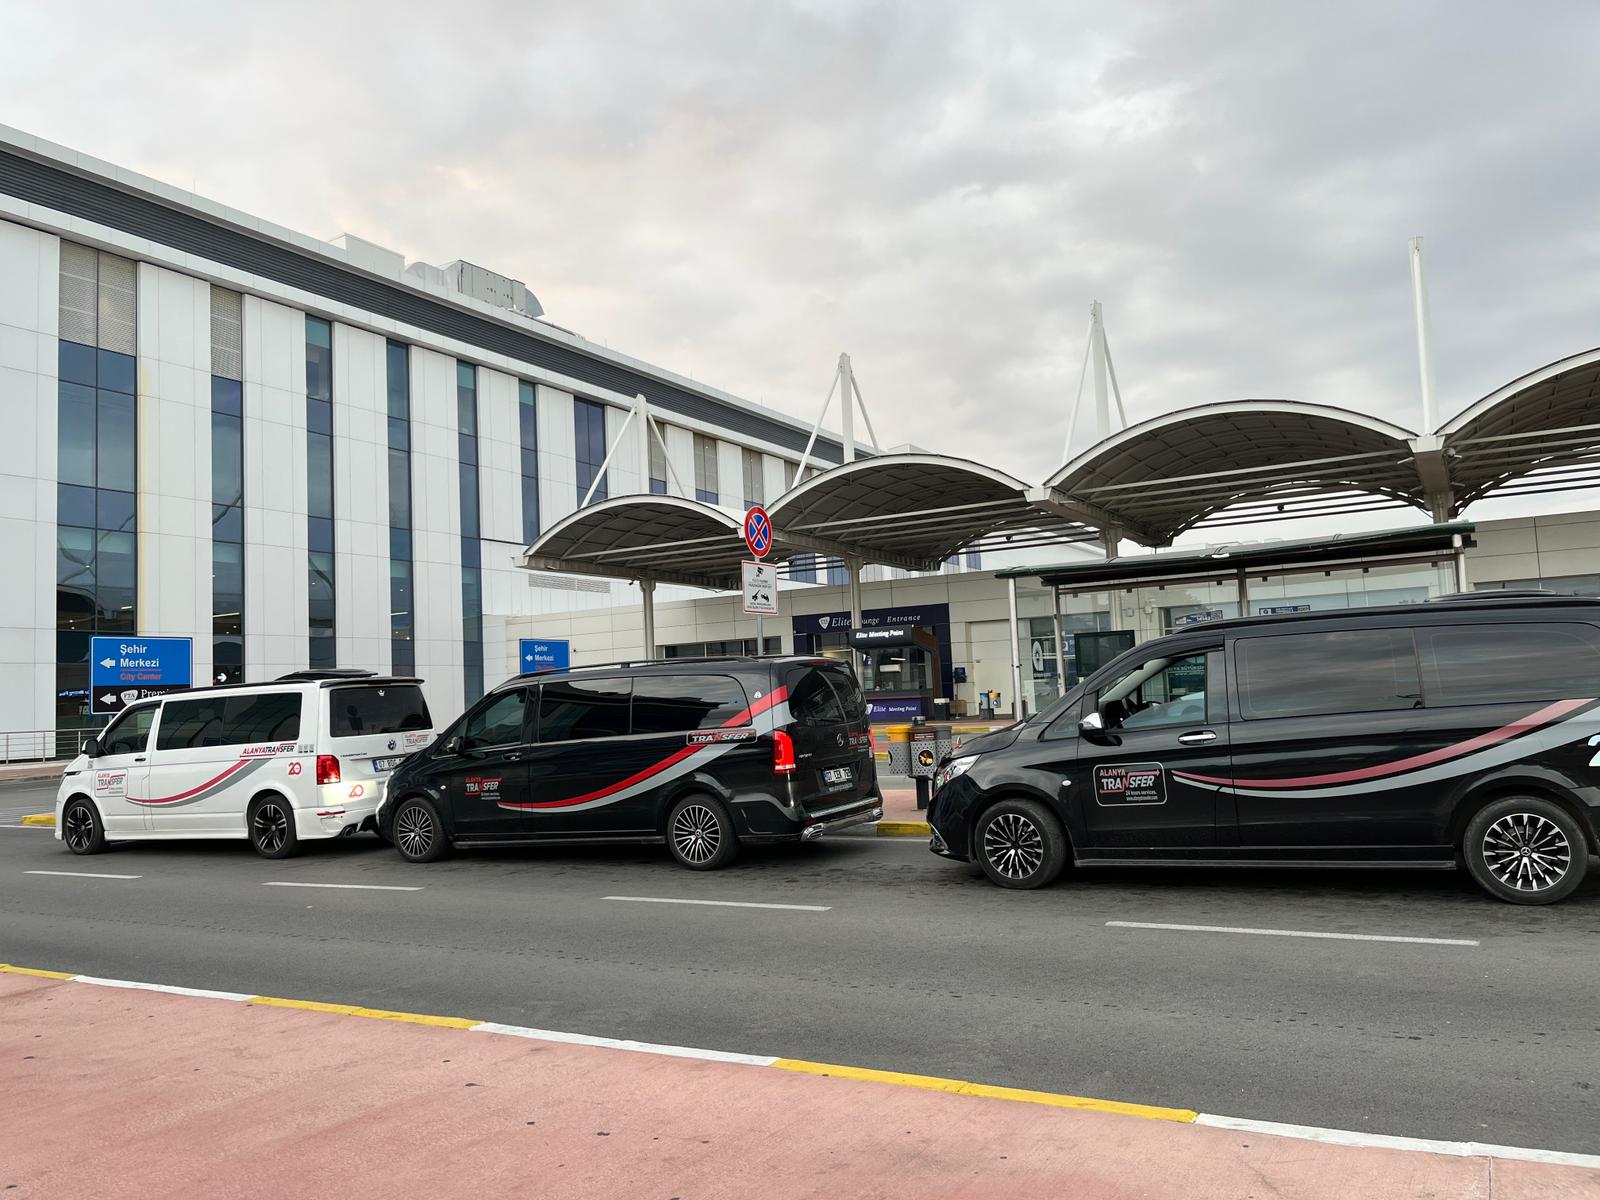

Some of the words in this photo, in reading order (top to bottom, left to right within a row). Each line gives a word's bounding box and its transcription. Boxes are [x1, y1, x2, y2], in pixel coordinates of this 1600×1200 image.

[831, 617, 852, 627] Elite
[886, 615, 920, 623] Entrance
[868, 630, 889, 638] Meeting
[889, 629, 904, 637] Point
[120, 644, 147, 655] Şehir
[120, 658, 160, 668] Merkezi
[534, 654, 555, 662] Merkezi
[120, 672, 136, 682] City
[137, 672, 162, 680] Center
[873, 704, 887, 713] Elite
[691, 732, 750, 743] TRANSFER
[287, 761, 302, 775] 20
[1100, 768, 1126, 777] ALANYA
[466, 781, 499, 792] TRANSFER
[1101, 775, 1155, 790] TRANSFER
